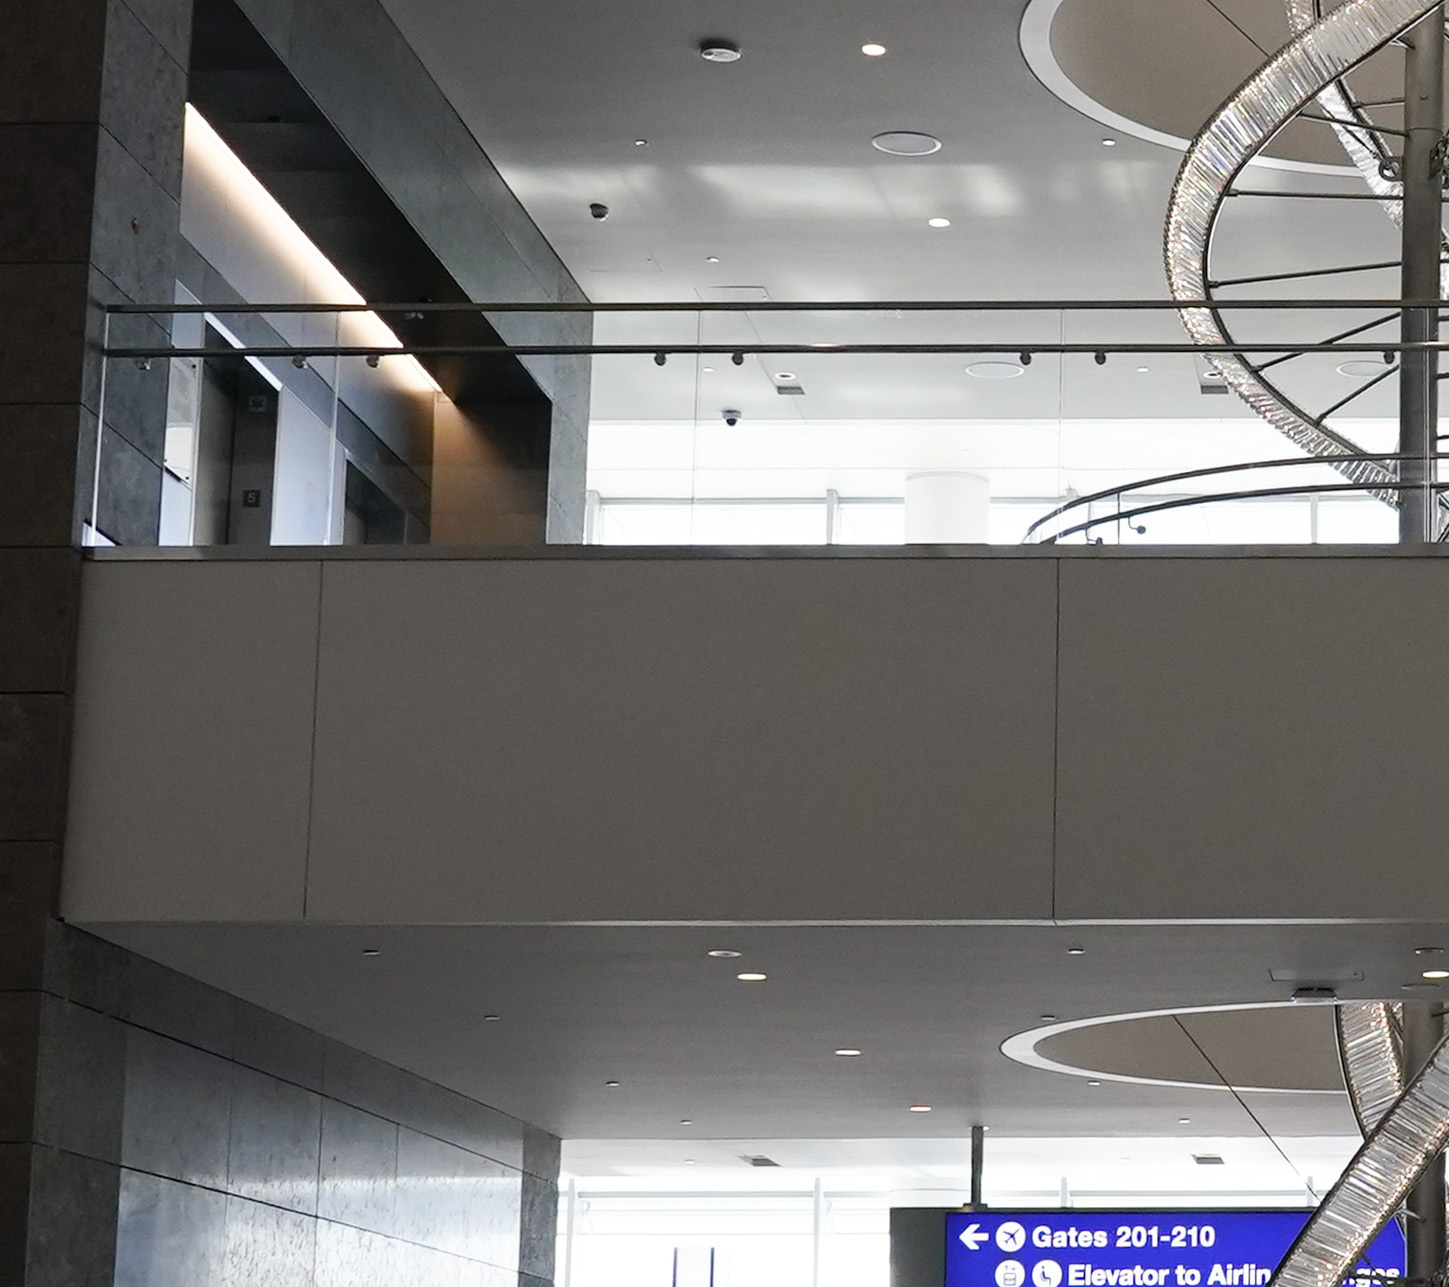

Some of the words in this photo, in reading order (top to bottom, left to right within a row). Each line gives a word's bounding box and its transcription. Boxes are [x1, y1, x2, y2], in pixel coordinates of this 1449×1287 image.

[1032, 1225, 1108, 1249] Gates
[1116, 1224, 1215, 1249] 201-210
[1067, 1264, 1171, 1287] Elevator
[1174, 1266, 1202, 1287] to
[1207, 1264, 1271, 1287] Airlin
